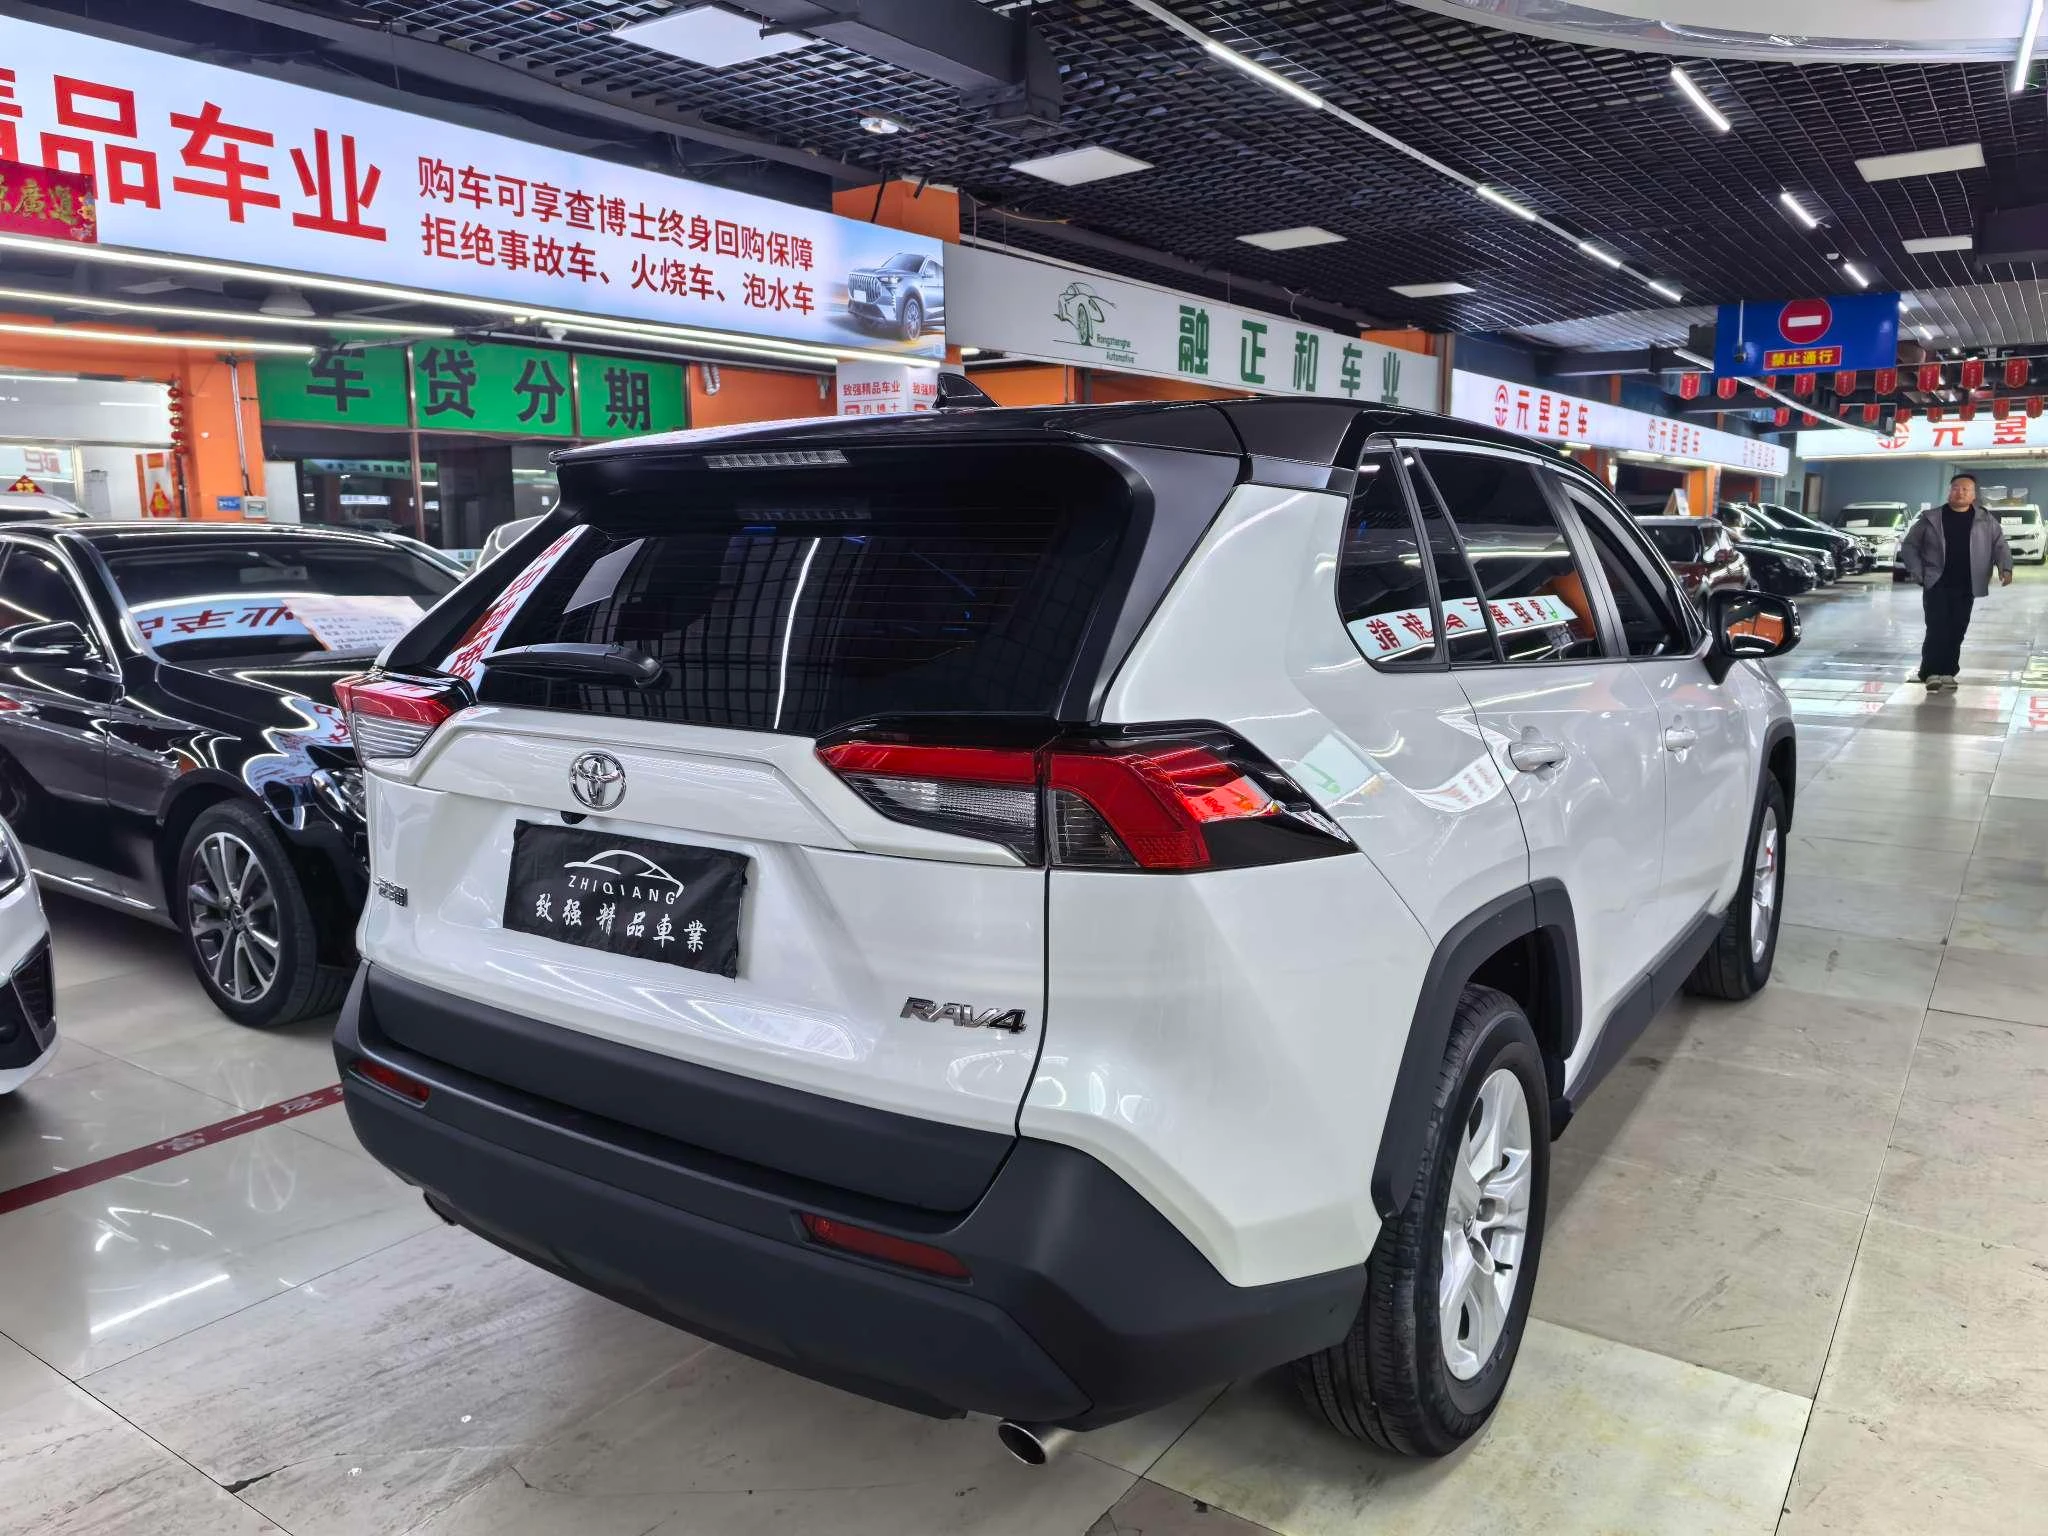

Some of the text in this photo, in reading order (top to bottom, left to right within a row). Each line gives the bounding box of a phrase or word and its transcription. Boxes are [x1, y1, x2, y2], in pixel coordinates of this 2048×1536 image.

[0, 67, 387, 242] 品车业
[418, 156, 815, 273] 购车可享查博士终身回购保障
[421, 213, 815, 315] 拒绝事故车、火烧车、泡水车
[305, 348, 653, 431] 车贷分期
[1178, 304, 1401, 404] 融正和车业
[1771, 349, 1834, 367] 禁止通行
[1515, 389, 1589, 438] 元昱名车
[535, 893, 708, 953] 致强精品車業
[568, 875, 676, 905] ZHIQIANG
[900, 996, 1027, 1034] RAV4
